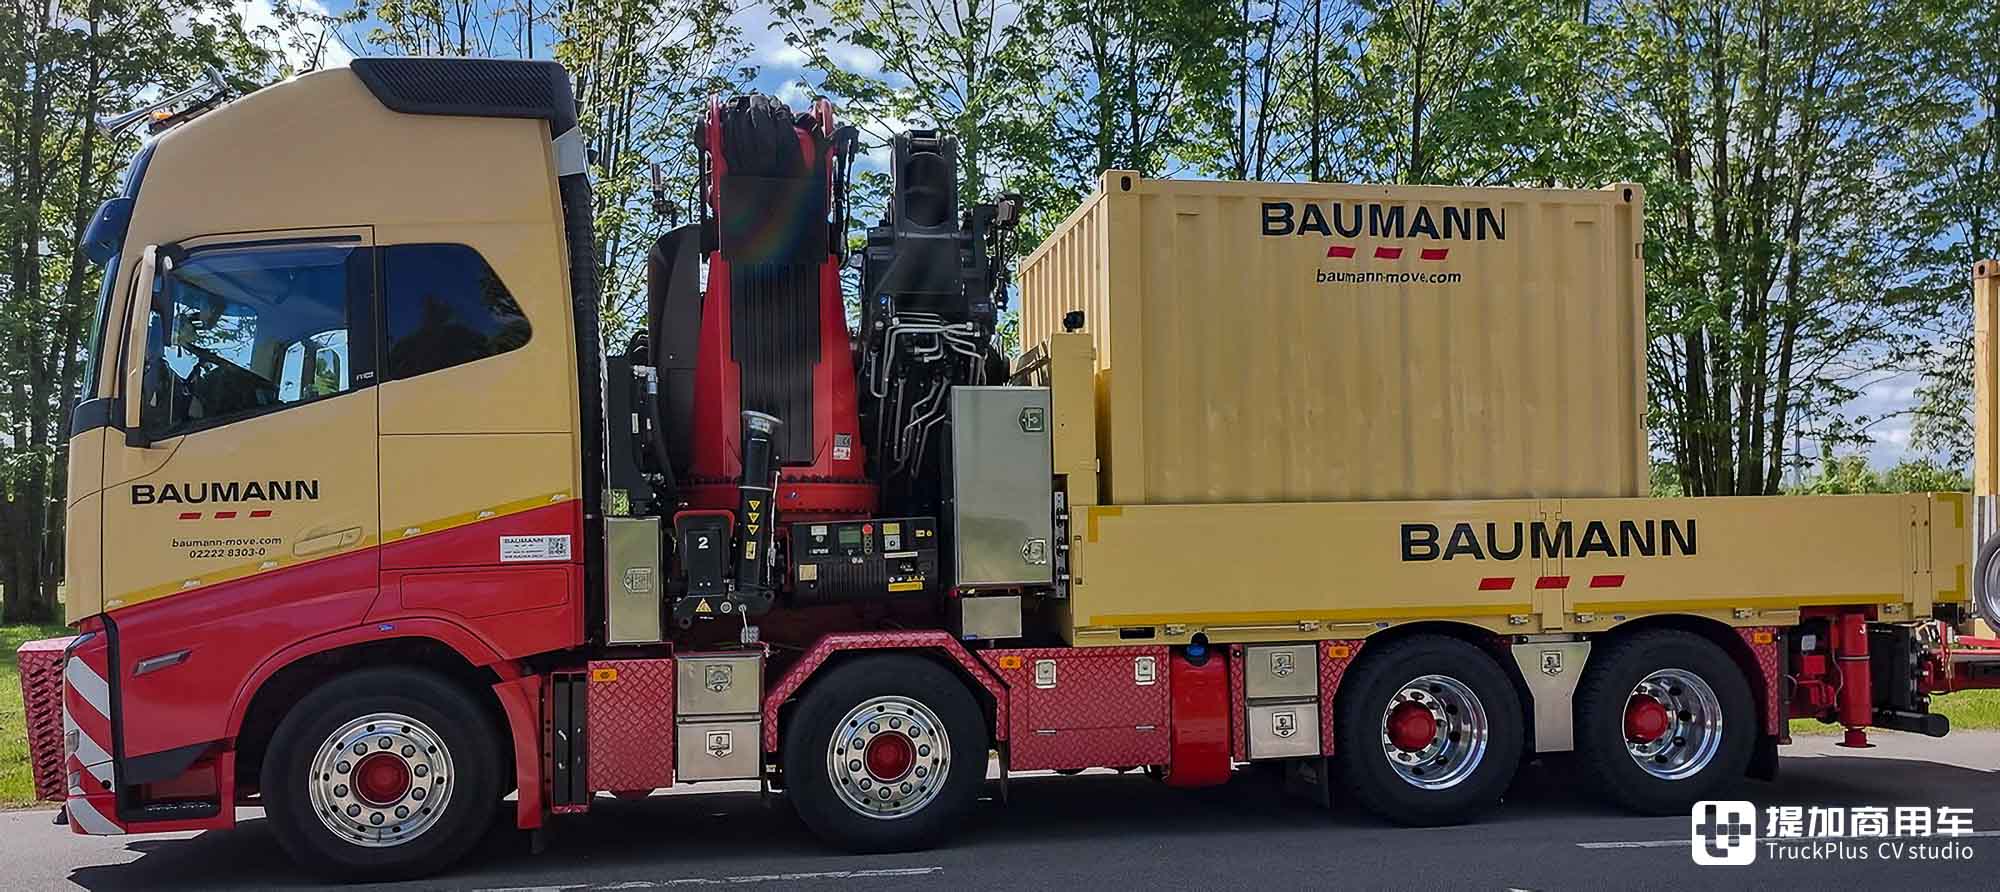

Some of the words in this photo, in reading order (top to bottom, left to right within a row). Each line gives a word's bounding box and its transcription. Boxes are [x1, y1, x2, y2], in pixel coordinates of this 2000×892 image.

[1261, 202, 1506, 241] BAUMANN
[1316, 268, 1462, 284] baumann-move.com
[131, 480, 319, 505] BAUMANN
[171, 536, 282, 549] baumann-move.com
[697, 536, 709, 550] 2
[1400, 519, 1697, 561] BAUMANN
[189, 549, 225, 559] 02222
[228, 547, 266, 558] 8303-0
